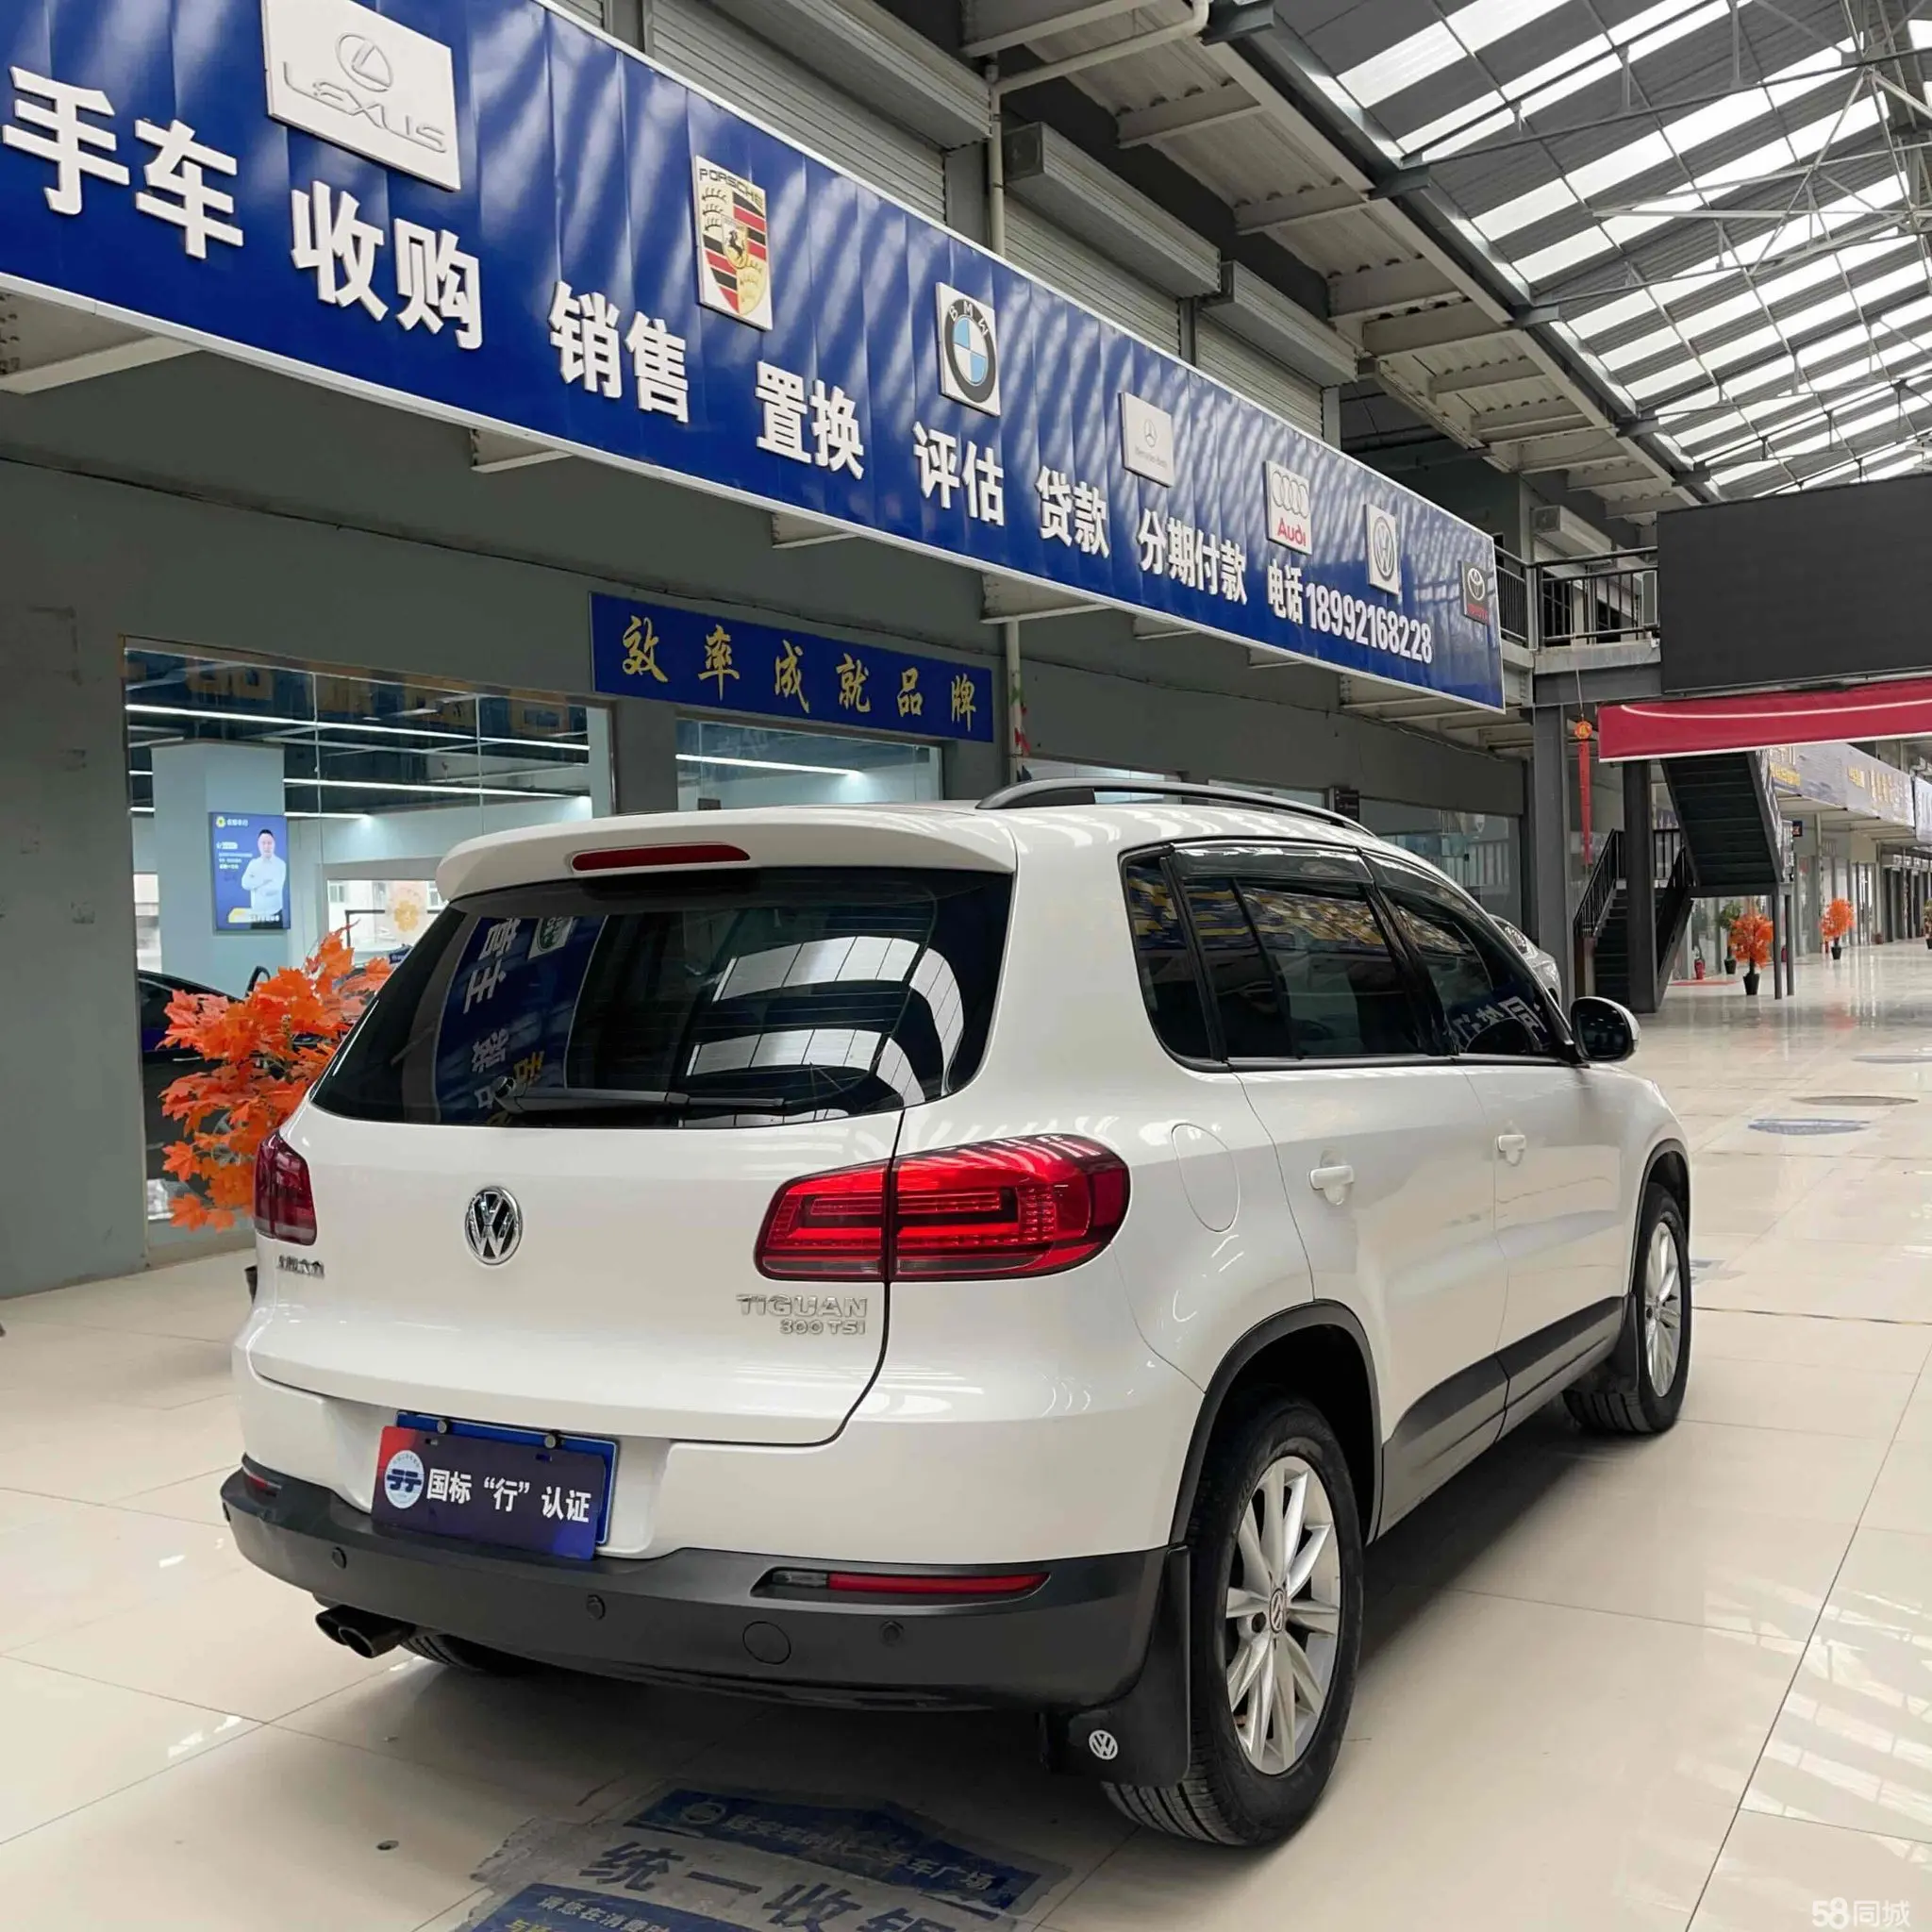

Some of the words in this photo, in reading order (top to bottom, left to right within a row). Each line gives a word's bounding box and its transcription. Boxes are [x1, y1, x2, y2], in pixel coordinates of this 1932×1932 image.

[699, 168, 763, 209] PORSCHE
[3, 66, 243, 259] 手车
[291, 180, 483, 350] 收购
[549, 280, 689, 424] 销售
[756, 361, 864, 479] 置换
[912, 421, 1004, 527] 评估
[1035, 465, 1109, 558] 贷款
[1137, 508, 1248, 606] 分期付款
[949, 300, 990, 338] BMW
[1277, 518, 1307, 546] Audi
[736, 1293, 868, 1318] TIGUAN
[779, 1319, 824, 1335] 300
[827, 1320, 866, 1335] TSI
[426, 1468, 473, 1504] 国标
[541, 1486, 592, 1523] 认证
